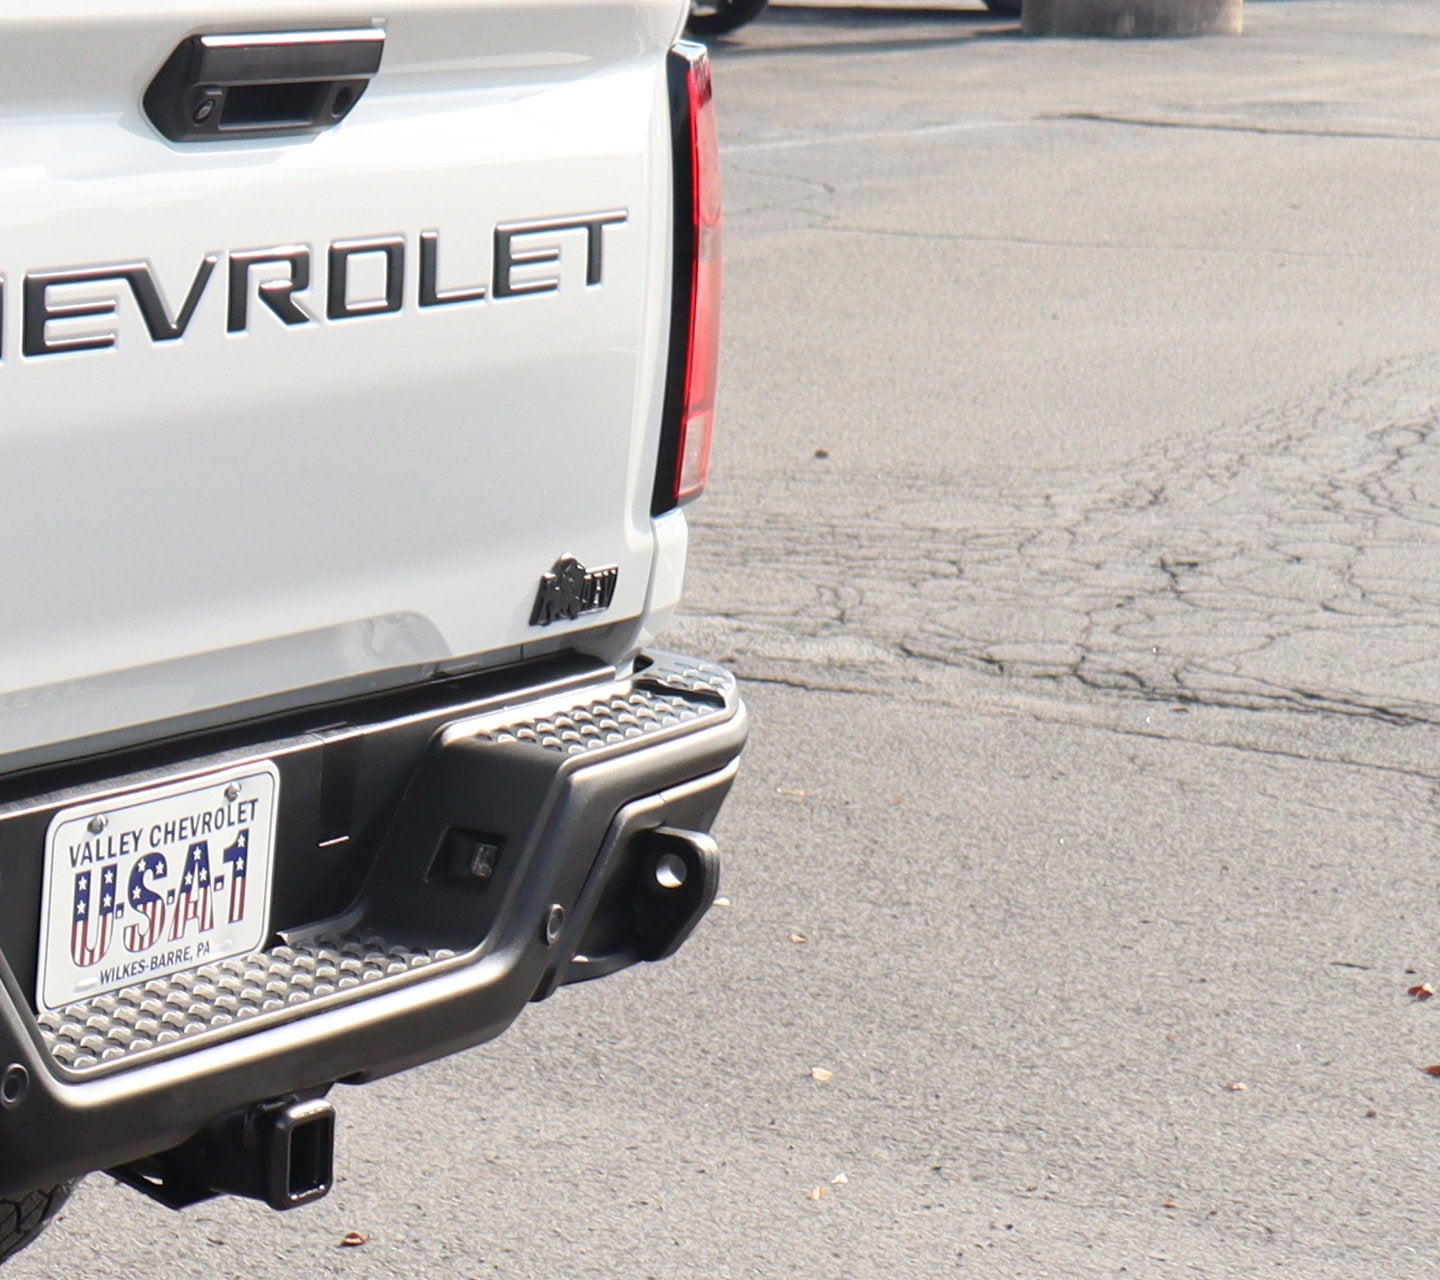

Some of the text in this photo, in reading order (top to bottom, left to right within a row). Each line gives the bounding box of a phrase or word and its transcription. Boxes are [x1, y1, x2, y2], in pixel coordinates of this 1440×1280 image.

[68, 797, 259, 869] VALLEY CHEVROLET
[99, 939, 211, 986] WILKES-BARRE, PA
